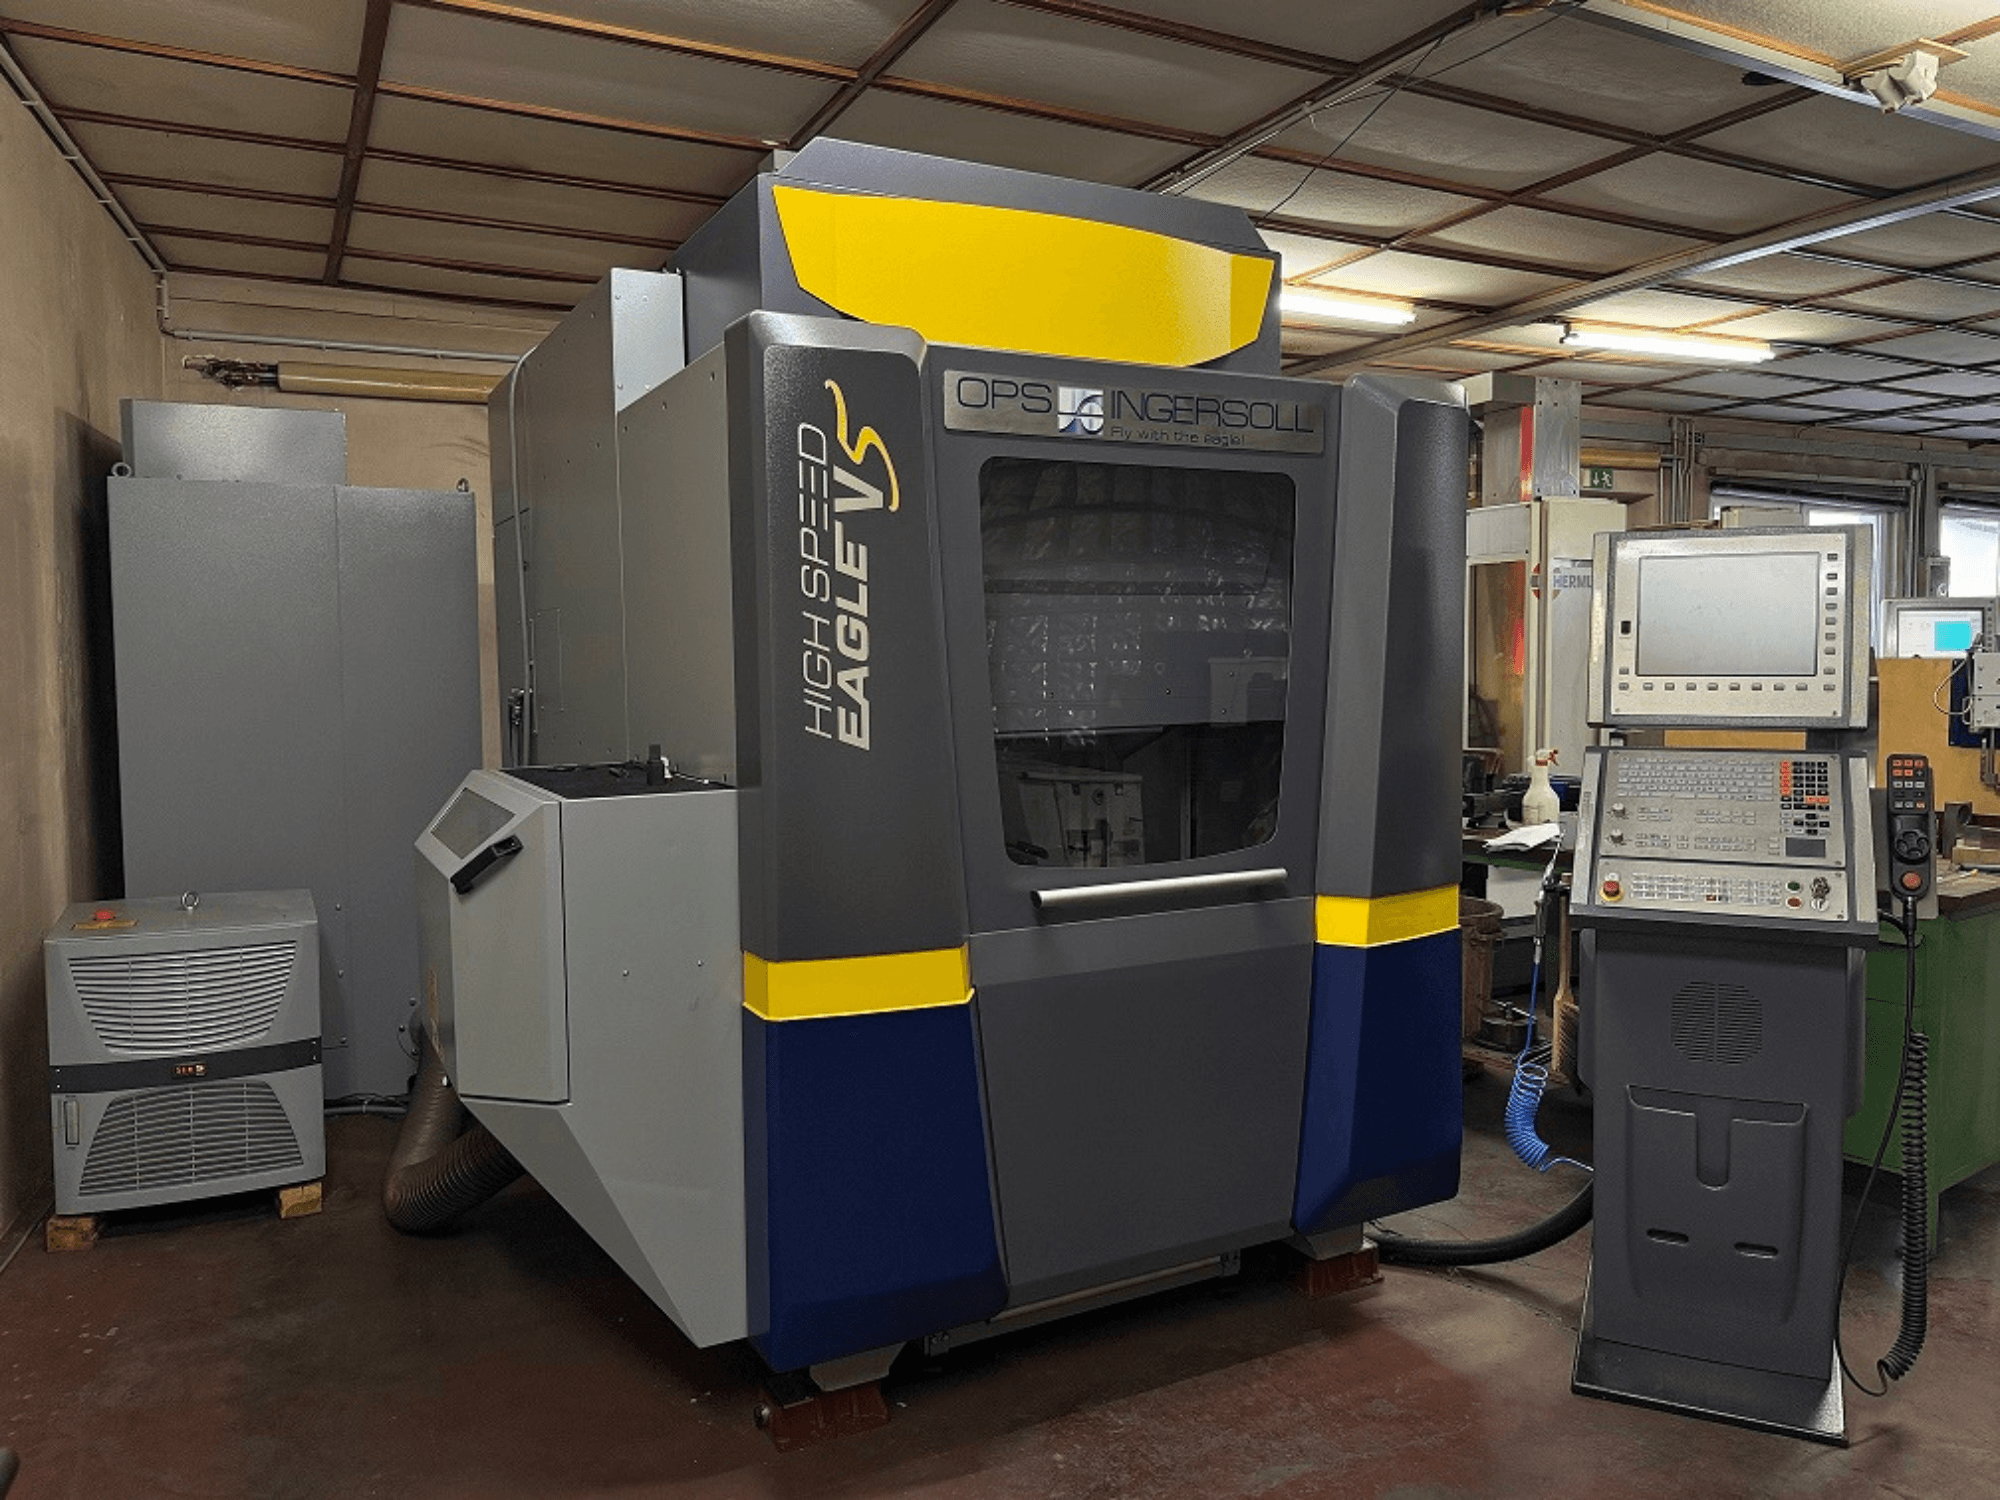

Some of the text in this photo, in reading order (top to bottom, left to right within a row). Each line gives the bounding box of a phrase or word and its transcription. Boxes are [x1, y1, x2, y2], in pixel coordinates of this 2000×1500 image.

[957, 377, 1314, 433] OPS INGERSOLL
[1110, 426, 1131, 440] Fly
[1139, 429, 1169, 441] with
[1174, 432, 1199, 443] the
[798, 422, 833, 739] HIGH SPEED
[1552, 574, 1592, 588] HERML
[834, 520, 870, 751] EAGLE
